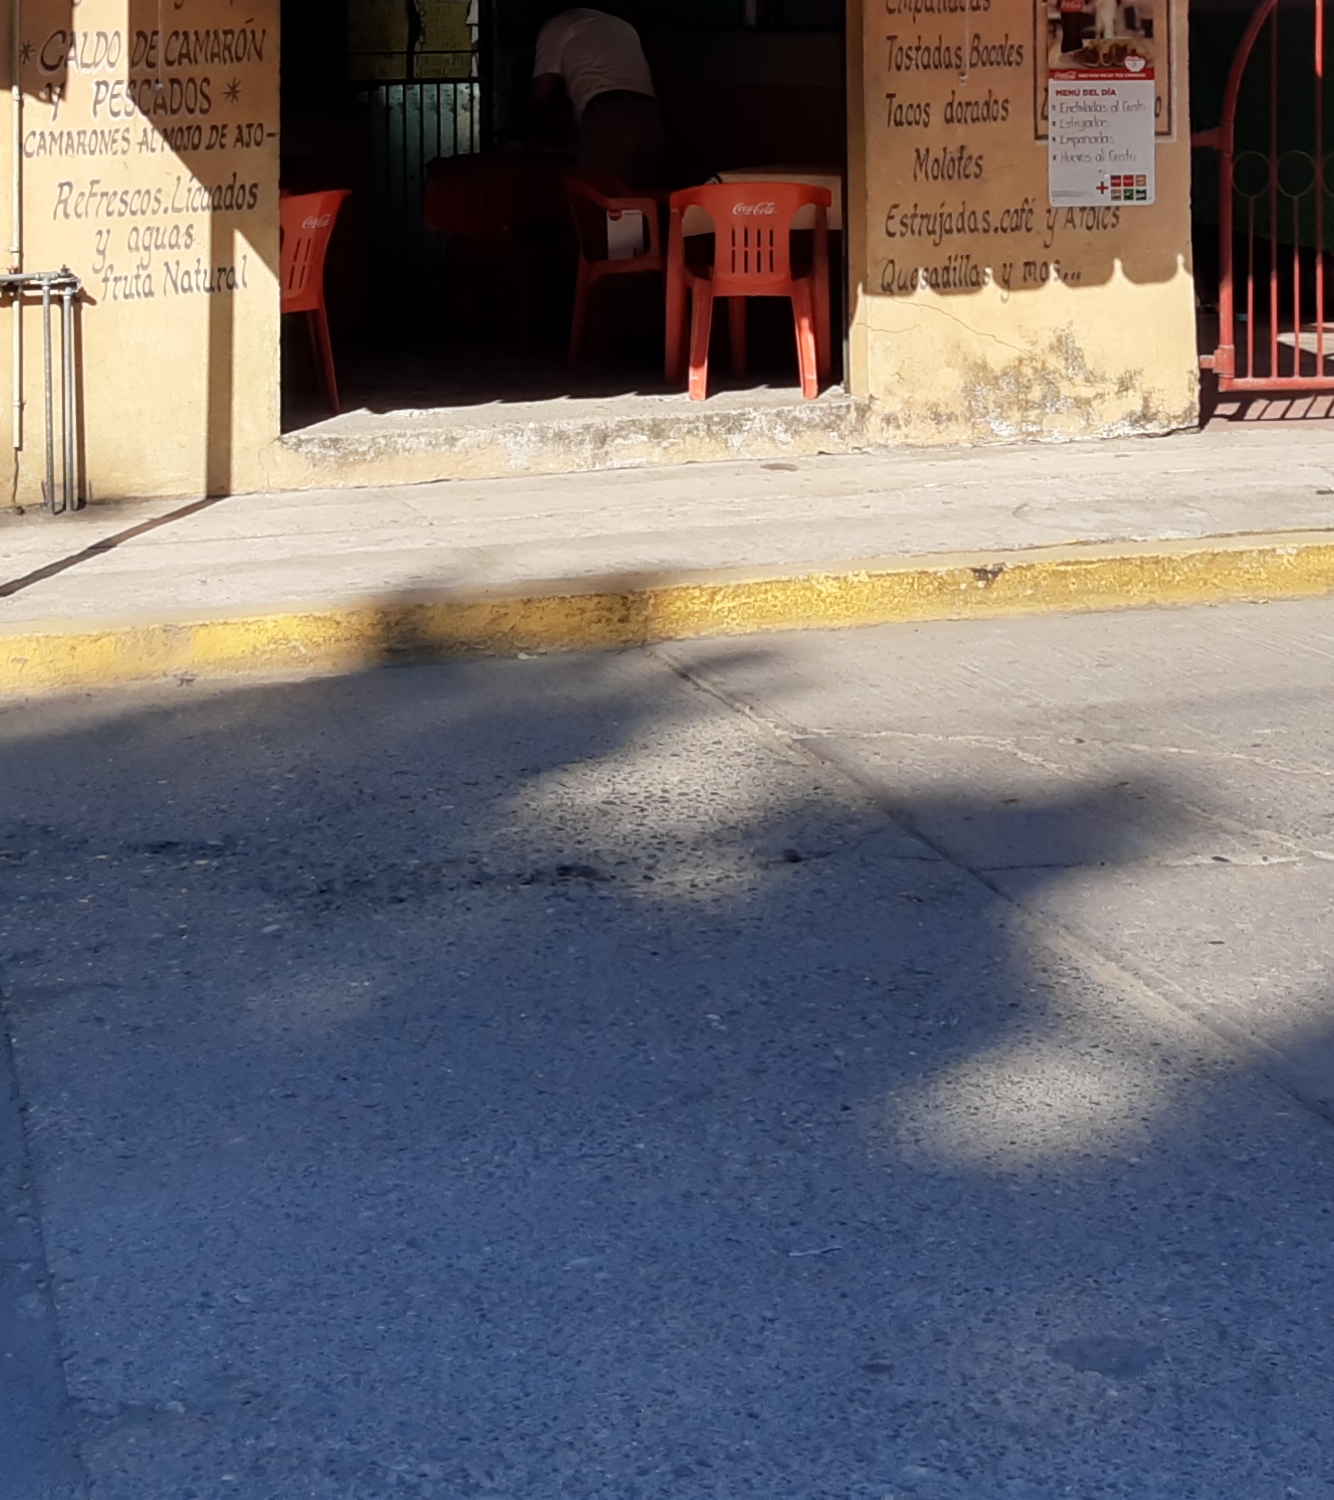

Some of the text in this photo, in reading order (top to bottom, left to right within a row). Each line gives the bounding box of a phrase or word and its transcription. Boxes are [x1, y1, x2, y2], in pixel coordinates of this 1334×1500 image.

[38, 17, 267, 72] CALDO DE CAMARÓN
[92, 77, 212, 119] PESCADOS
[885, 92, 931, 128] Tacos
[943, 88, 1010, 125] dorados
[1082, 88, 1100, 97] DEL
[23, 126, 132, 159] CAMARONES
[137, 127, 158, 155] AL
[161, 124, 203, 154] MOJO
[205, 123, 229, 151] DE
[913, 144, 984, 182] Molotes
[732, 201, 776, 216] Coca-Cola
[1043, 206, 1059, 248] y
[92, 222, 195, 275] y aguas
[101, 254, 249, 302] fruta Natural
[1001, 261, 1013, 304] y
